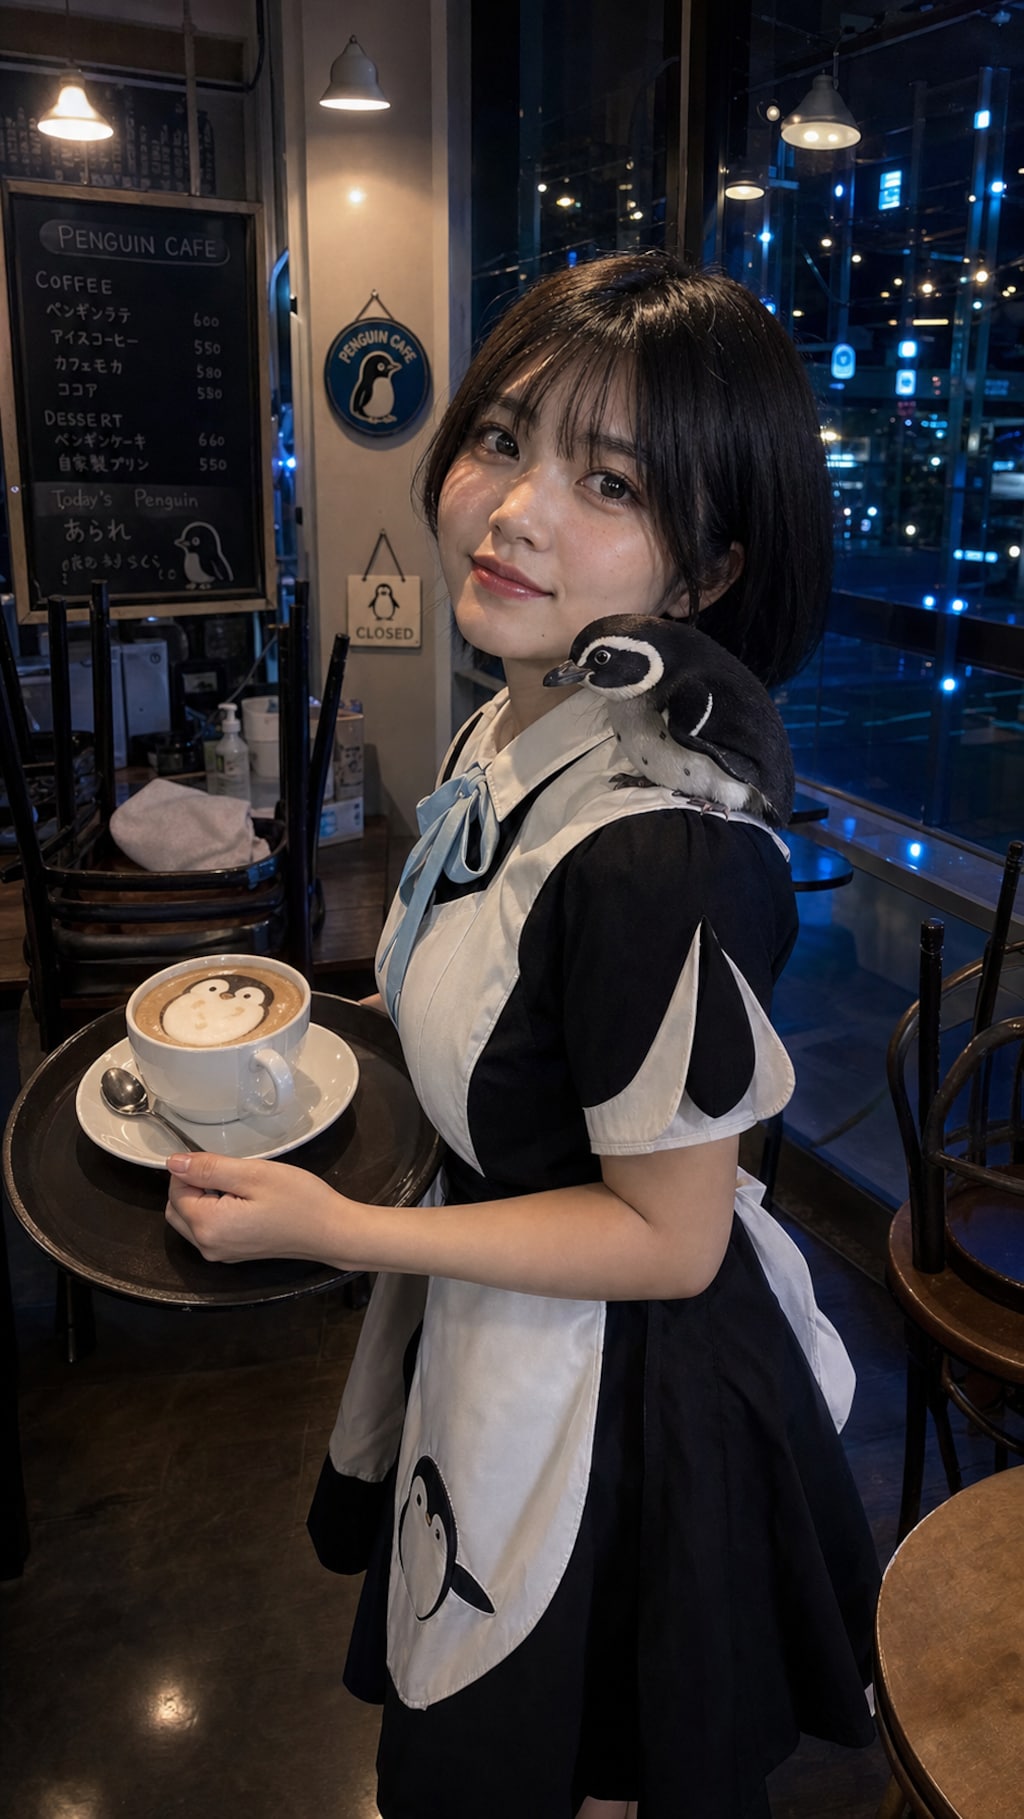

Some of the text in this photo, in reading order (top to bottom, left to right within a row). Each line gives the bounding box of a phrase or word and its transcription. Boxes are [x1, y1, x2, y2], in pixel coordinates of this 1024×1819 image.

[58, 225, 217, 258] PENGUIN CAFE
[35, 270, 113, 295] COFFEE
[46, 302, 219, 328] ペンギンラテ 600
[51, 329, 221, 356] アイスコーヒー 550
[338, 329, 417, 364] PENGUIN CAFE
[54, 356, 222, 380] カフェモカ 580
[58, 383, 97, 398] ココア
[44, 410, 123, 428] DESSERT
[54, 432, 225, 450] ペンギンケーキ 660
[58, 453, 227, 472] 自家製プリン 550
[51, 489, 199, 510] Today's Penguin
[64, 518, 131, 543] あられ
[356, 626, 414, 640] CLOSED
